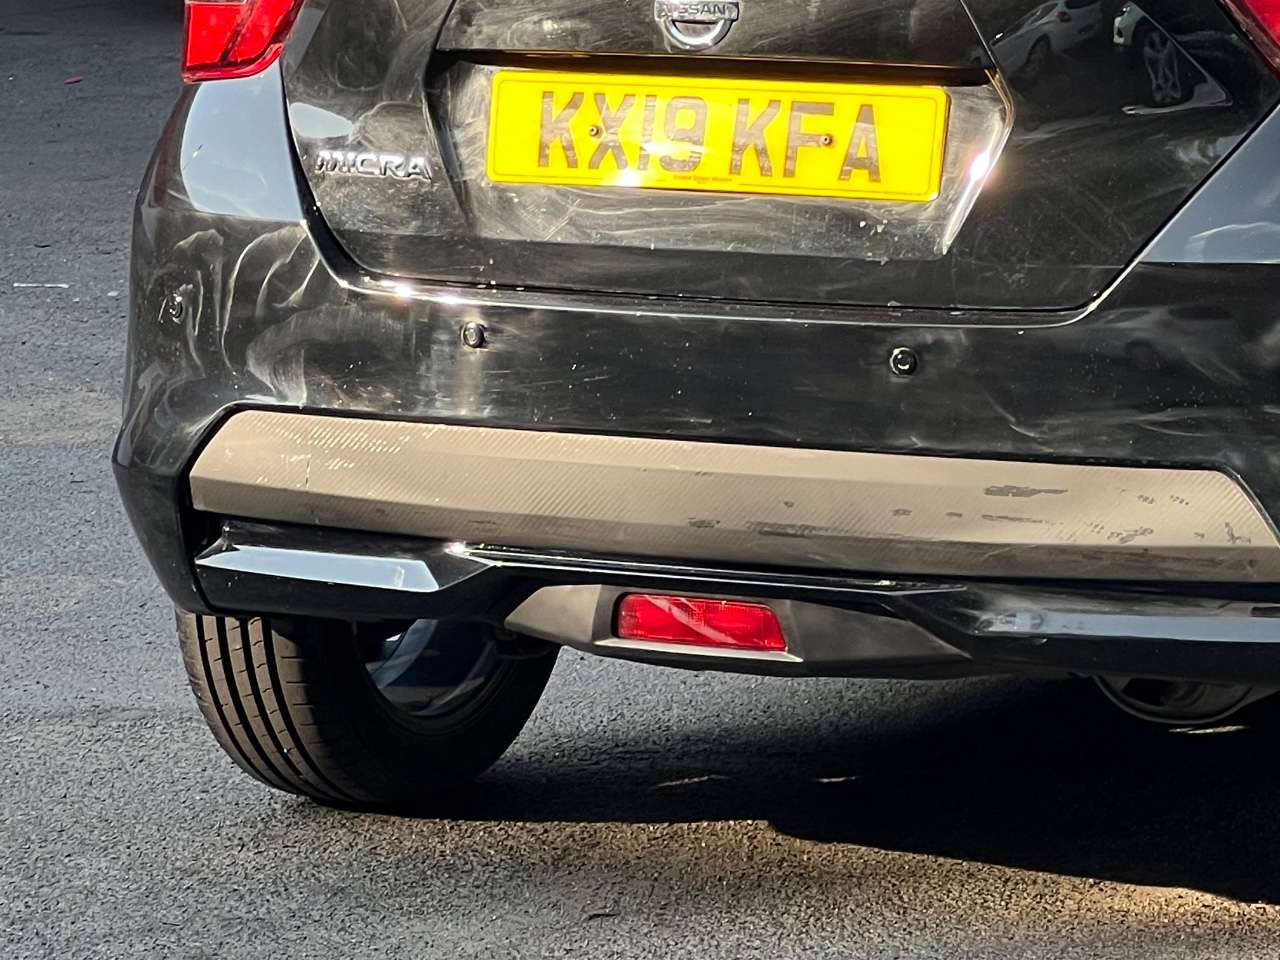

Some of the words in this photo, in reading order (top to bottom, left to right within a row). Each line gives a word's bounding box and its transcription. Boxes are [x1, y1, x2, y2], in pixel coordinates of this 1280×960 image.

[314, 150, 432, 181] MICRA
[537, 90, 708, 173] KX19
[728, 97, 881, 183] KFA
